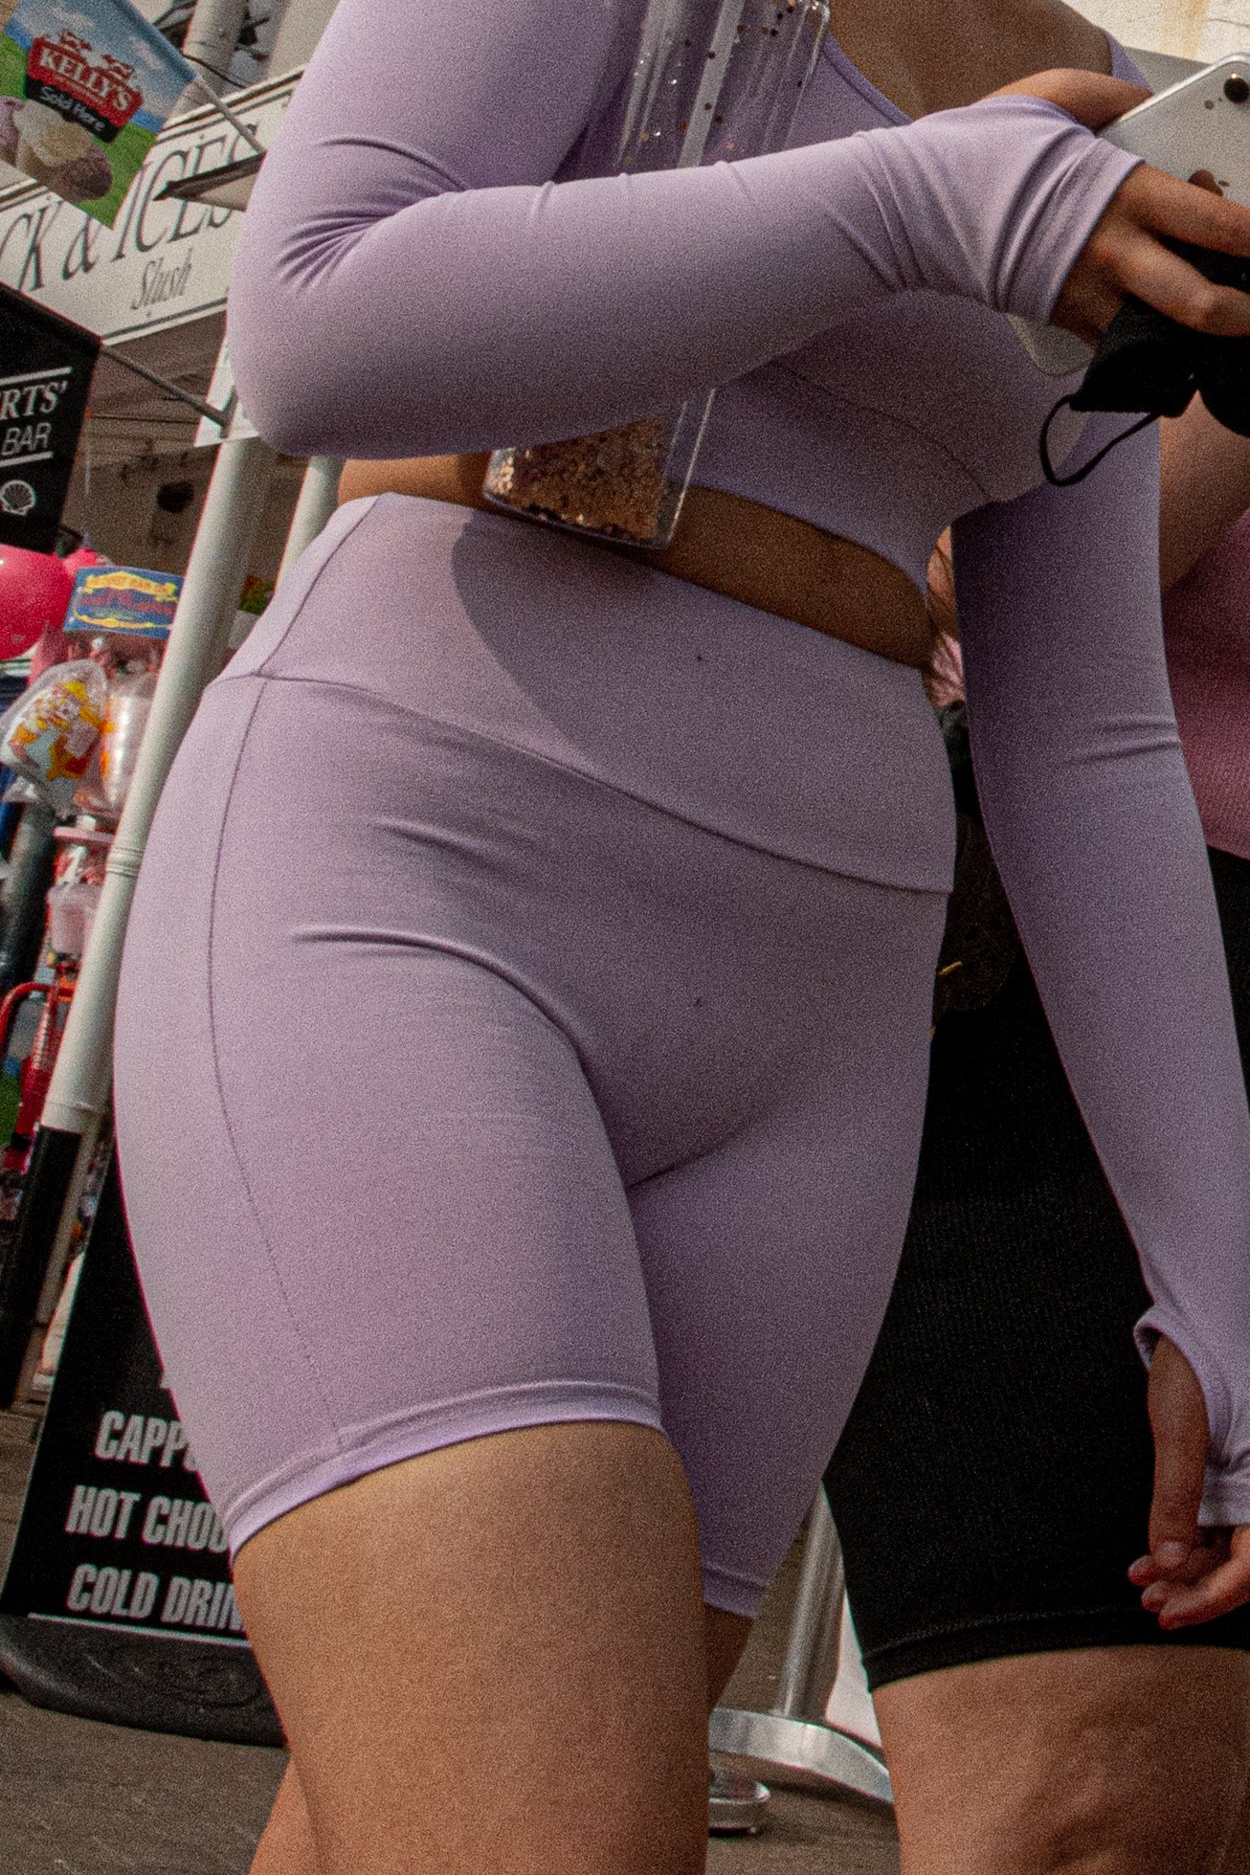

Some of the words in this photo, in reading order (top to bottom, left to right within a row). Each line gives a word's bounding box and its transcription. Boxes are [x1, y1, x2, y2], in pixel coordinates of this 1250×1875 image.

[1, 421, 52, 456] BAR
[65, 1484, 142, 1540] HOT
[66, 1563, 160, 1620] COLD
